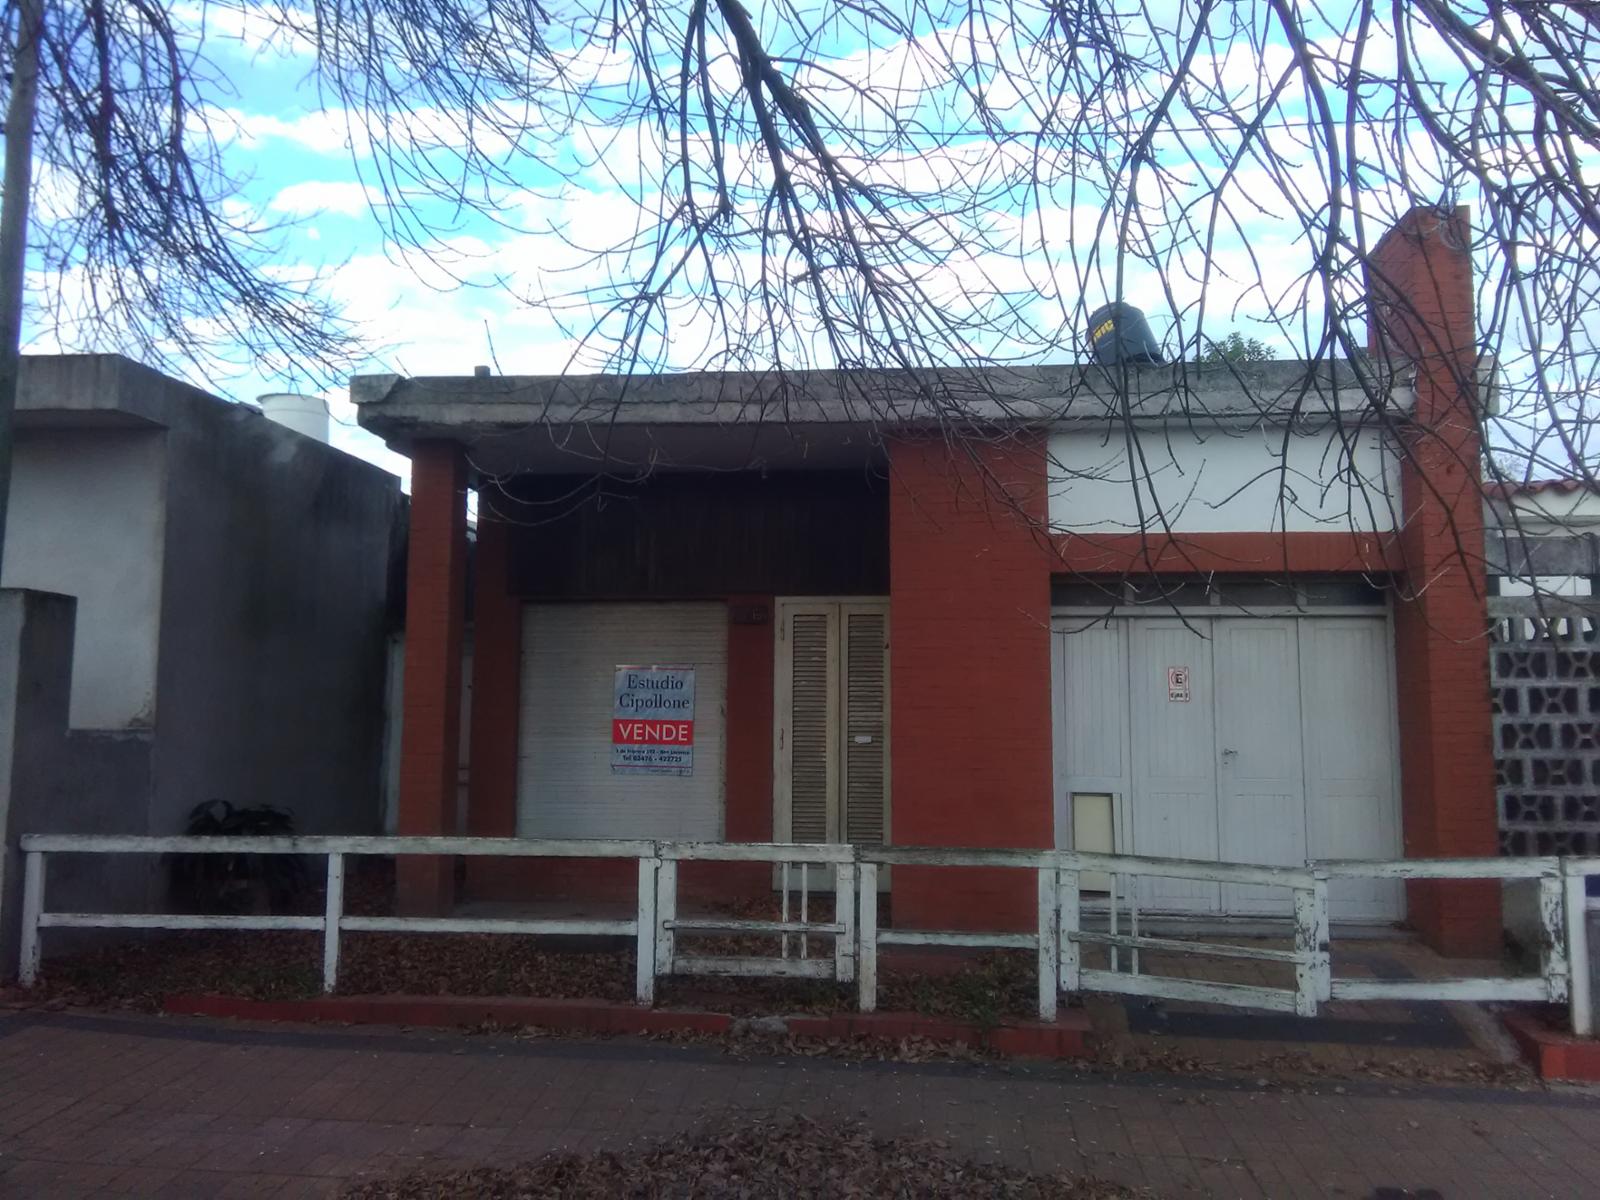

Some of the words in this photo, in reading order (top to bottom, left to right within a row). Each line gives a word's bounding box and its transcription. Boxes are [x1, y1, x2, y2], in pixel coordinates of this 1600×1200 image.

[627, 674, 684, 690] Estudio
[1175, 673, 1183, 684] E
[619, 693, 690, 712] Cipollone
[619, 723, 689, 741] VENDE
